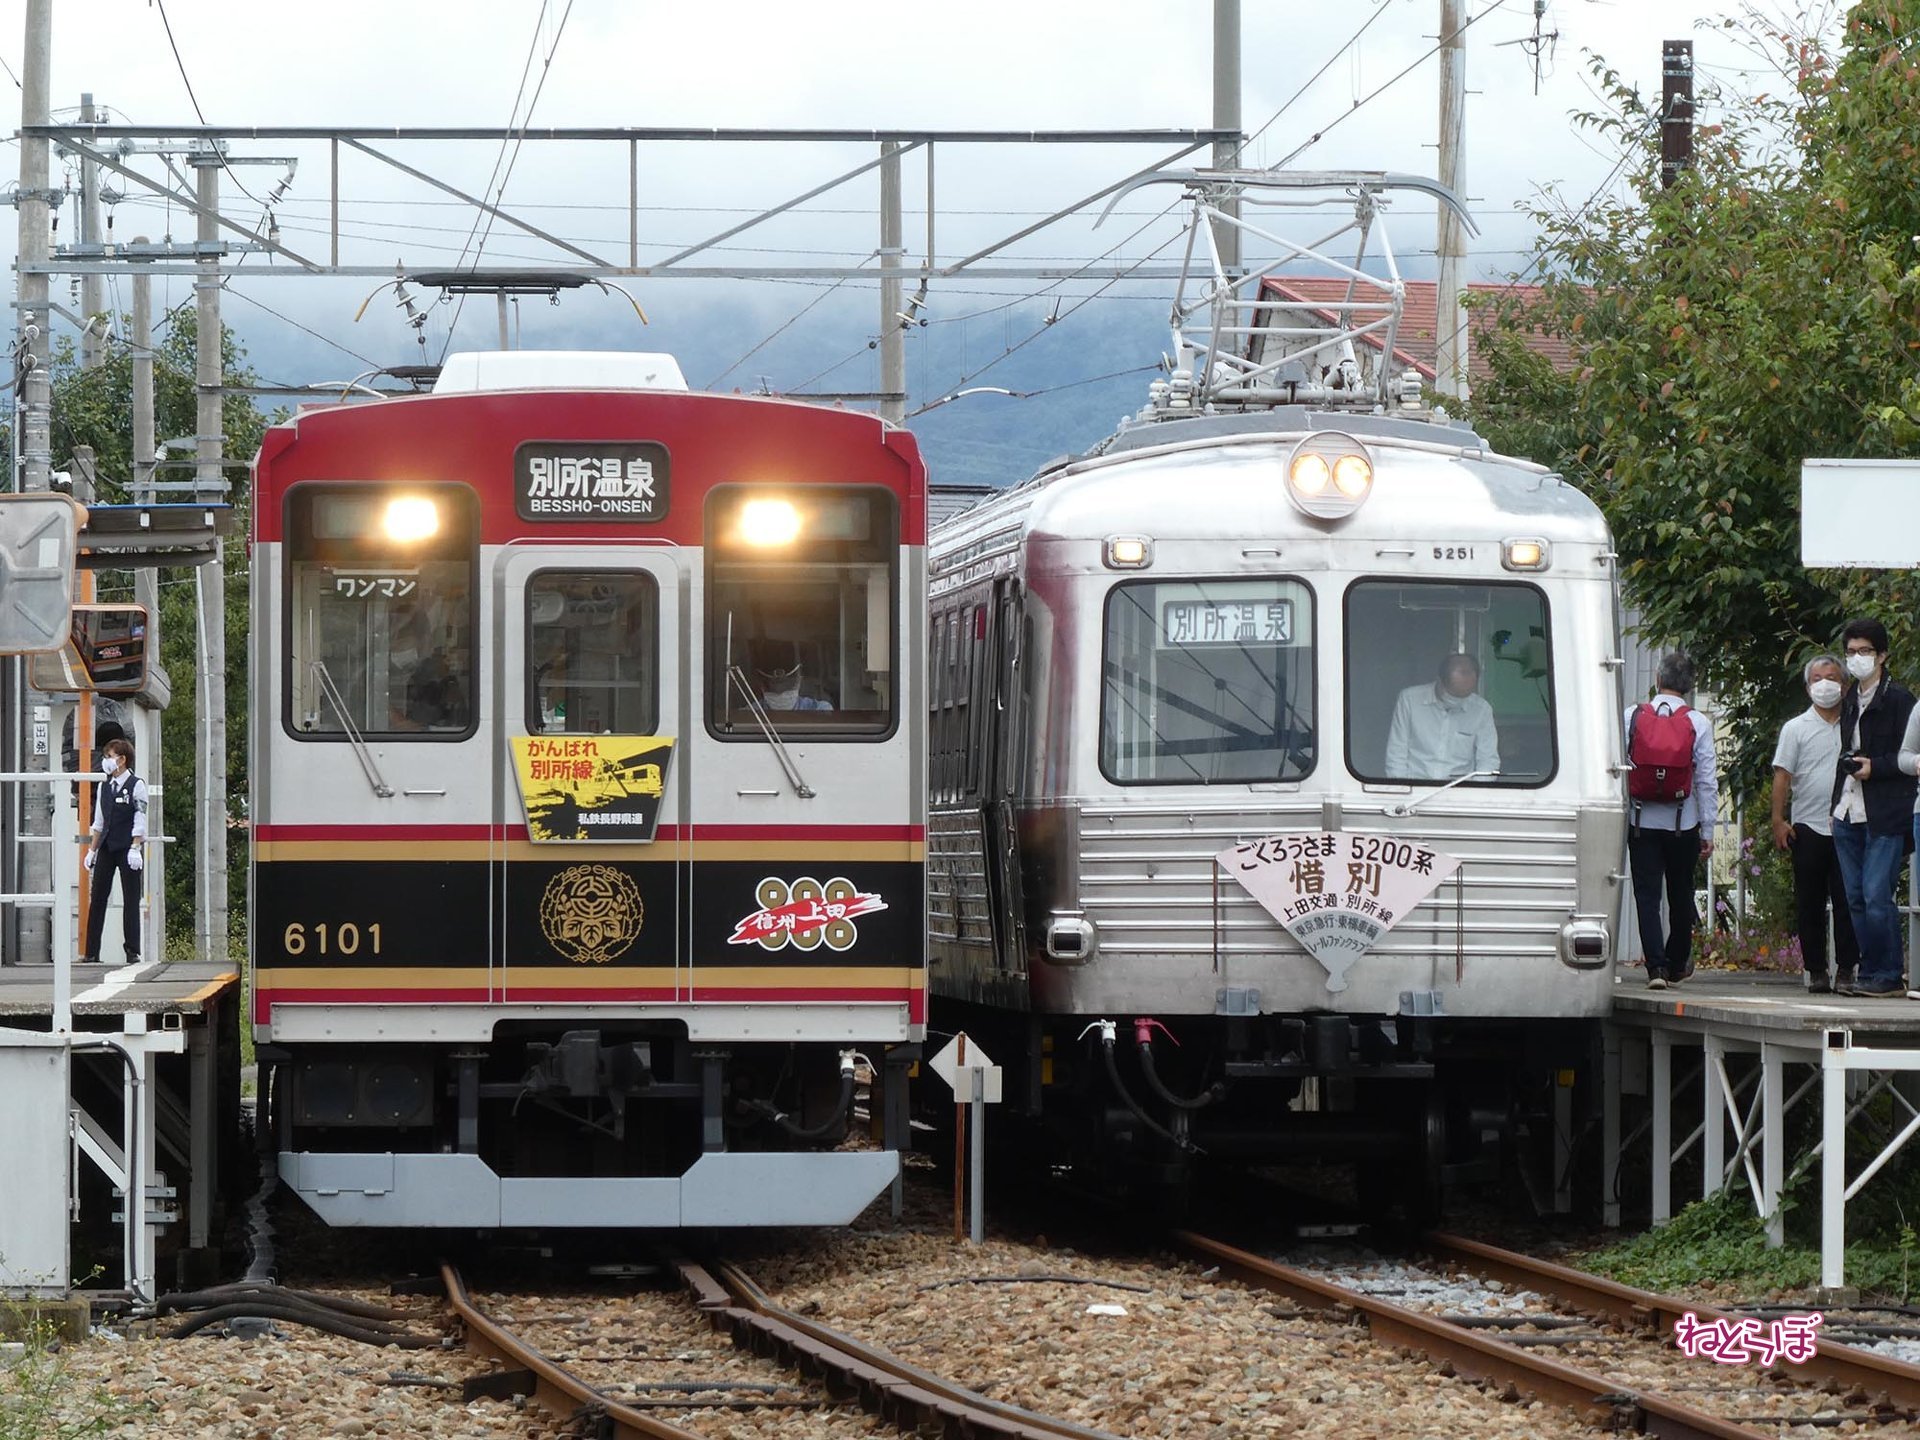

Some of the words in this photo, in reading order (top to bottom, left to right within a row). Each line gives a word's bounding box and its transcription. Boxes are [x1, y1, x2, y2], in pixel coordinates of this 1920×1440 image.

[527, 457, 656, 498] 別所温泉
[530, 499, 652, 513] BESSHO-ONSEN
[1433, 547, 1474, 560] 5251
[337, 578, 416, 597] ワンマン
[1173, 604, 1288, 641] 別所温泉
[35, 725, 47, 753] 出発
[527, 739, 599, 757] がんばれ
[530, 759, 595, 781] 別所線
[1237, 834, 1337, 871] ごくろうさま
[1351, 836, 1436, 876] 5200系
[1289, 859, 1383, 898] 惜別
[284, 922, 380, 954] 6101
